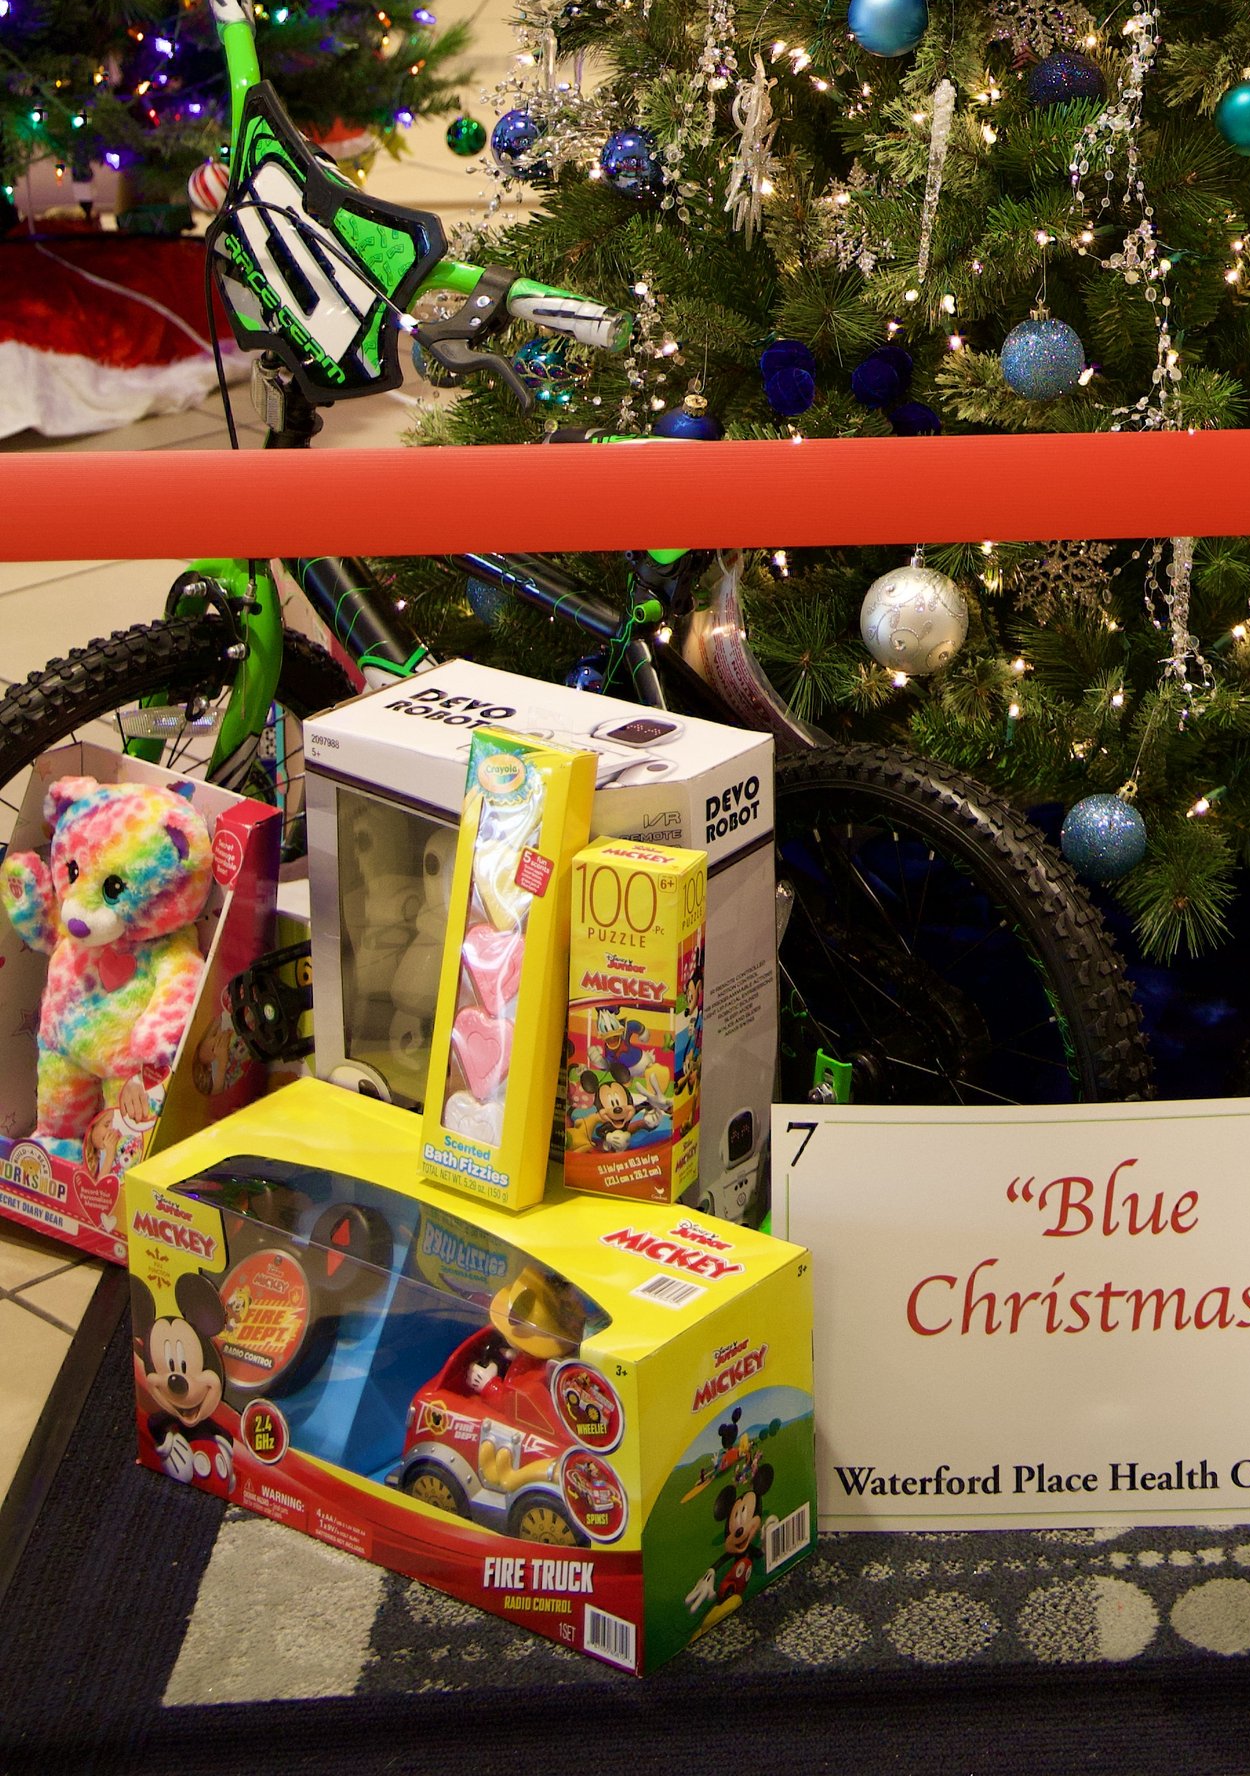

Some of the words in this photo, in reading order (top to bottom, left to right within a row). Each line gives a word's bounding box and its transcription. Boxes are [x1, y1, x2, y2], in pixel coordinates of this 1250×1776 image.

[384, 699, 494, 731] ROBOT
[409, 687, 518, 721] DEVO
[484, 762, 519, 777] Crayola
[705, 774, 760, 822] DEVO
[706, 799, 761, 844] ROBOT
[522, 850, 533, 864] 5
[601, 848, 675, 864] MICKEY
[660, 877, 675, 890] 6+
[574, 862, 658, 934] 100
[587, 927, 647, 949] PUZZLE
[580, 970, 668, 1003] MICKEY
[444, 1135, 491, 1161] Scented
[785, 1120, 820, 1168] 7
[422, 1162, 439, 1178] TOTAL
[440, 1169, 452, 1183] NET
[424, 1143, 458, 1170] Bath
[459, 1155, 510, 1188] Fizzies
[22, 1202, 43, 1220] DIARY
[44, 1212, 64, 1227] BEAR
[132, 1209, 218, 1261] MICKEY
[598, 1225, 746, 1281] MICKEY
[246, 1307, 286, 1325] FIRE
[237, 1324, 288, 1343] DEPT.
[223, 1345, 245, 1359] RADIO
[243, 1351, 274, 1369] CONTROL
[615, 1364, 628, 1377] 3+
[690, 1343, 769, 1413] MICKEY
[254, 1414, 273, 1433] 2.4
[255, 1432, 275, 1452] GHz
[834, 1464, 1003, 1499] Waterford
[1012, 1463, 1100, 1495] Place
[1108, 1458, 1221, 1492] Health
[261, 1484, 305, 1513] WARNING:
[483, 1556, 526, 1590] FIRE
[531, 1559, 595, 1594] TRUCK
[504, 1595, 532, 1611] RADIO
[532, 1597, 573, 1614] CONTROL
